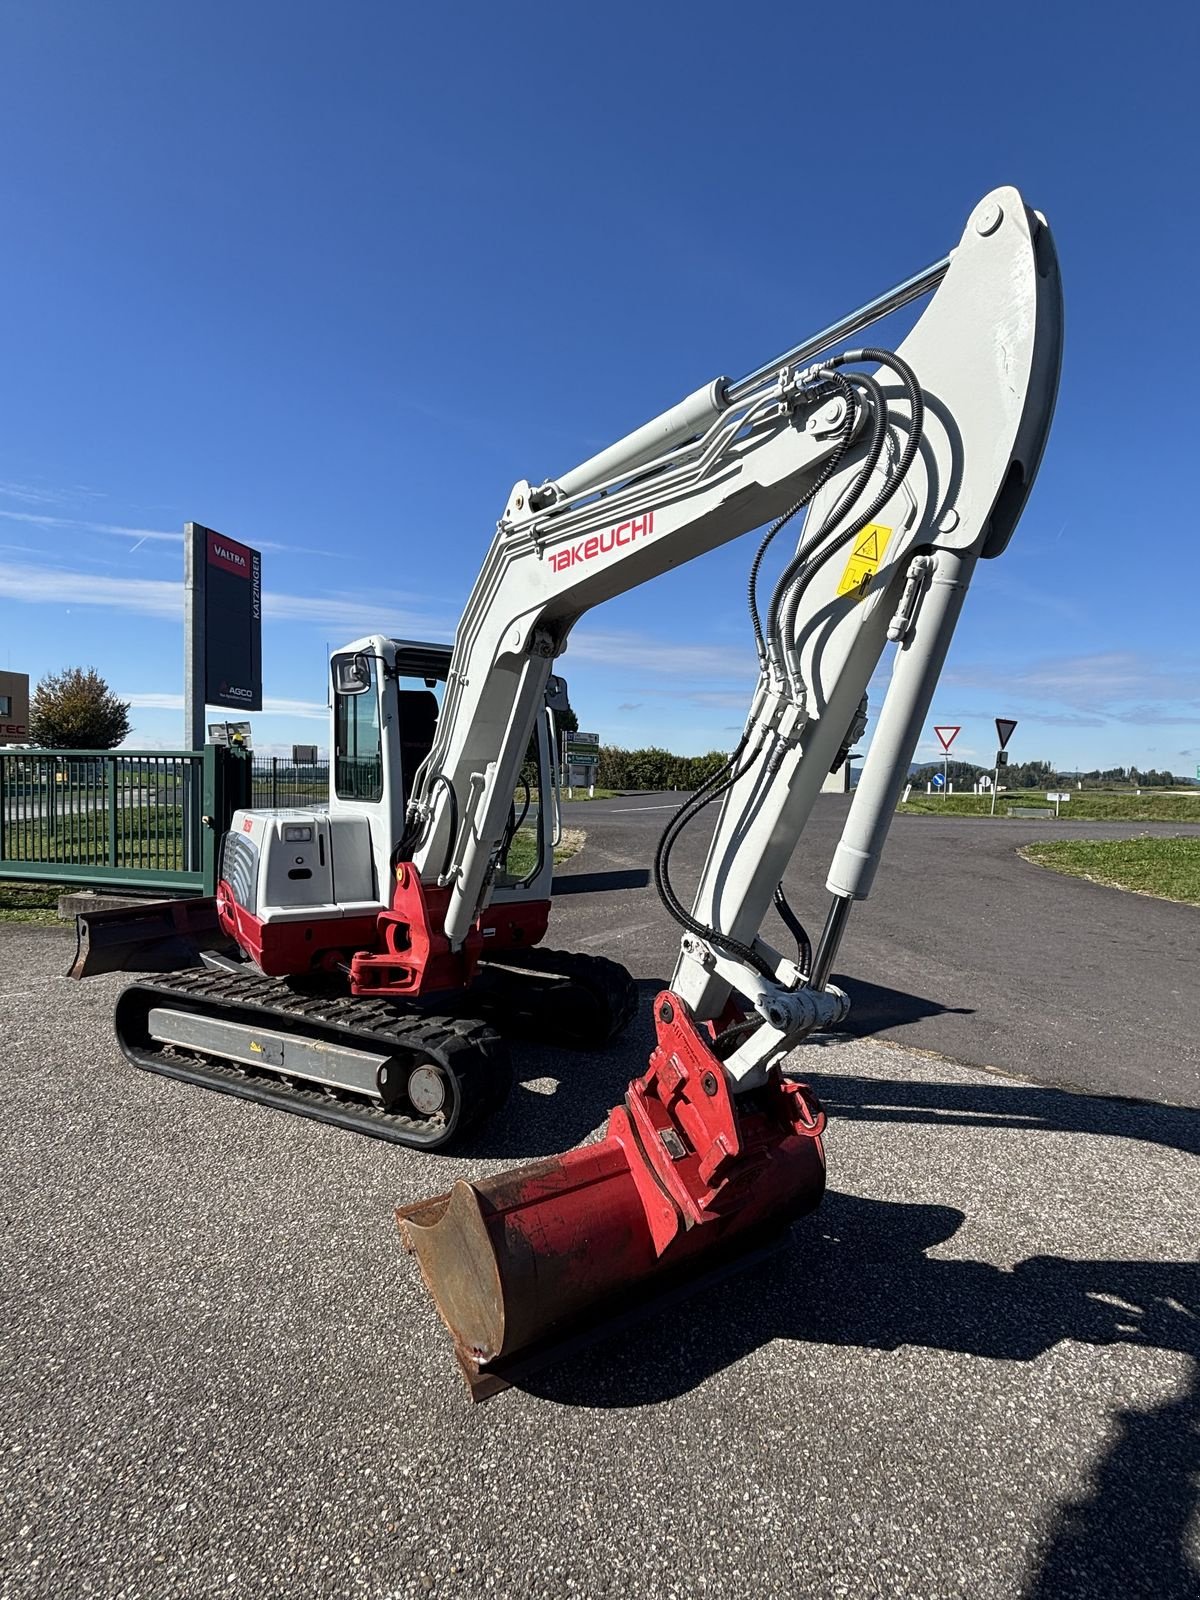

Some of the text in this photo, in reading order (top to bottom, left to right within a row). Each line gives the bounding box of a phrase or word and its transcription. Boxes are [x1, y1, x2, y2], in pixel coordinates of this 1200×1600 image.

[213, 543, 246, 567] VALTRA
[548, 511, 654, 573] TAKEUCHI
[252, 556, 260, 620] KATZINGER
[229, 686, 253, 698] AGCO
